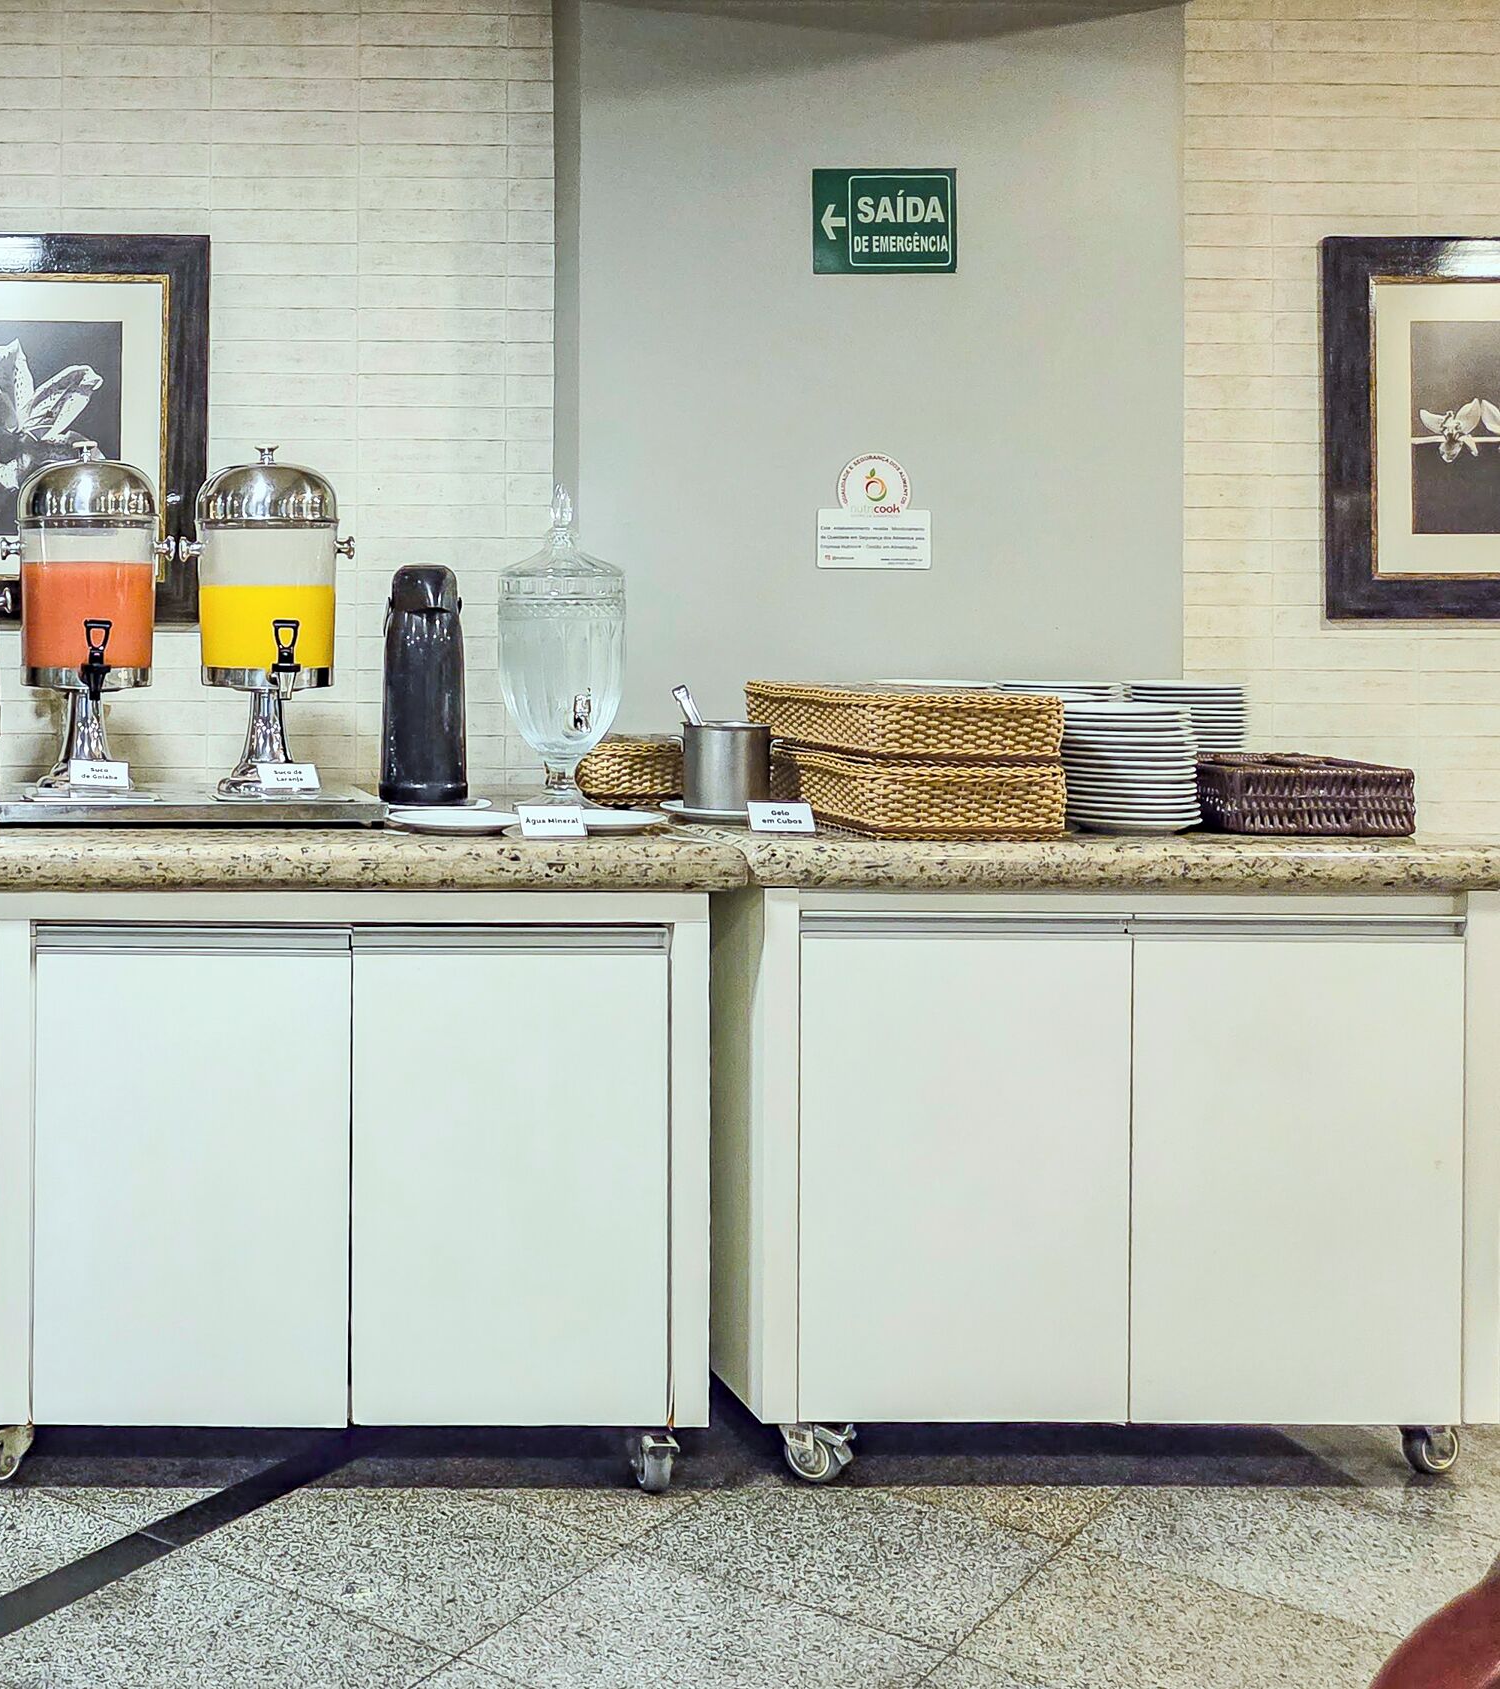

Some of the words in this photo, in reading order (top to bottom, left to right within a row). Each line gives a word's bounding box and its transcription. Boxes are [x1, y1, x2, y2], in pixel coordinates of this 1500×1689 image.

[857, 190, 945, 223] SAÍDA
[854, 235, 869, 253] DE
[873, 232, 948, 253] EMERGÊNCIA
[525, 816, 546, 825] Água
